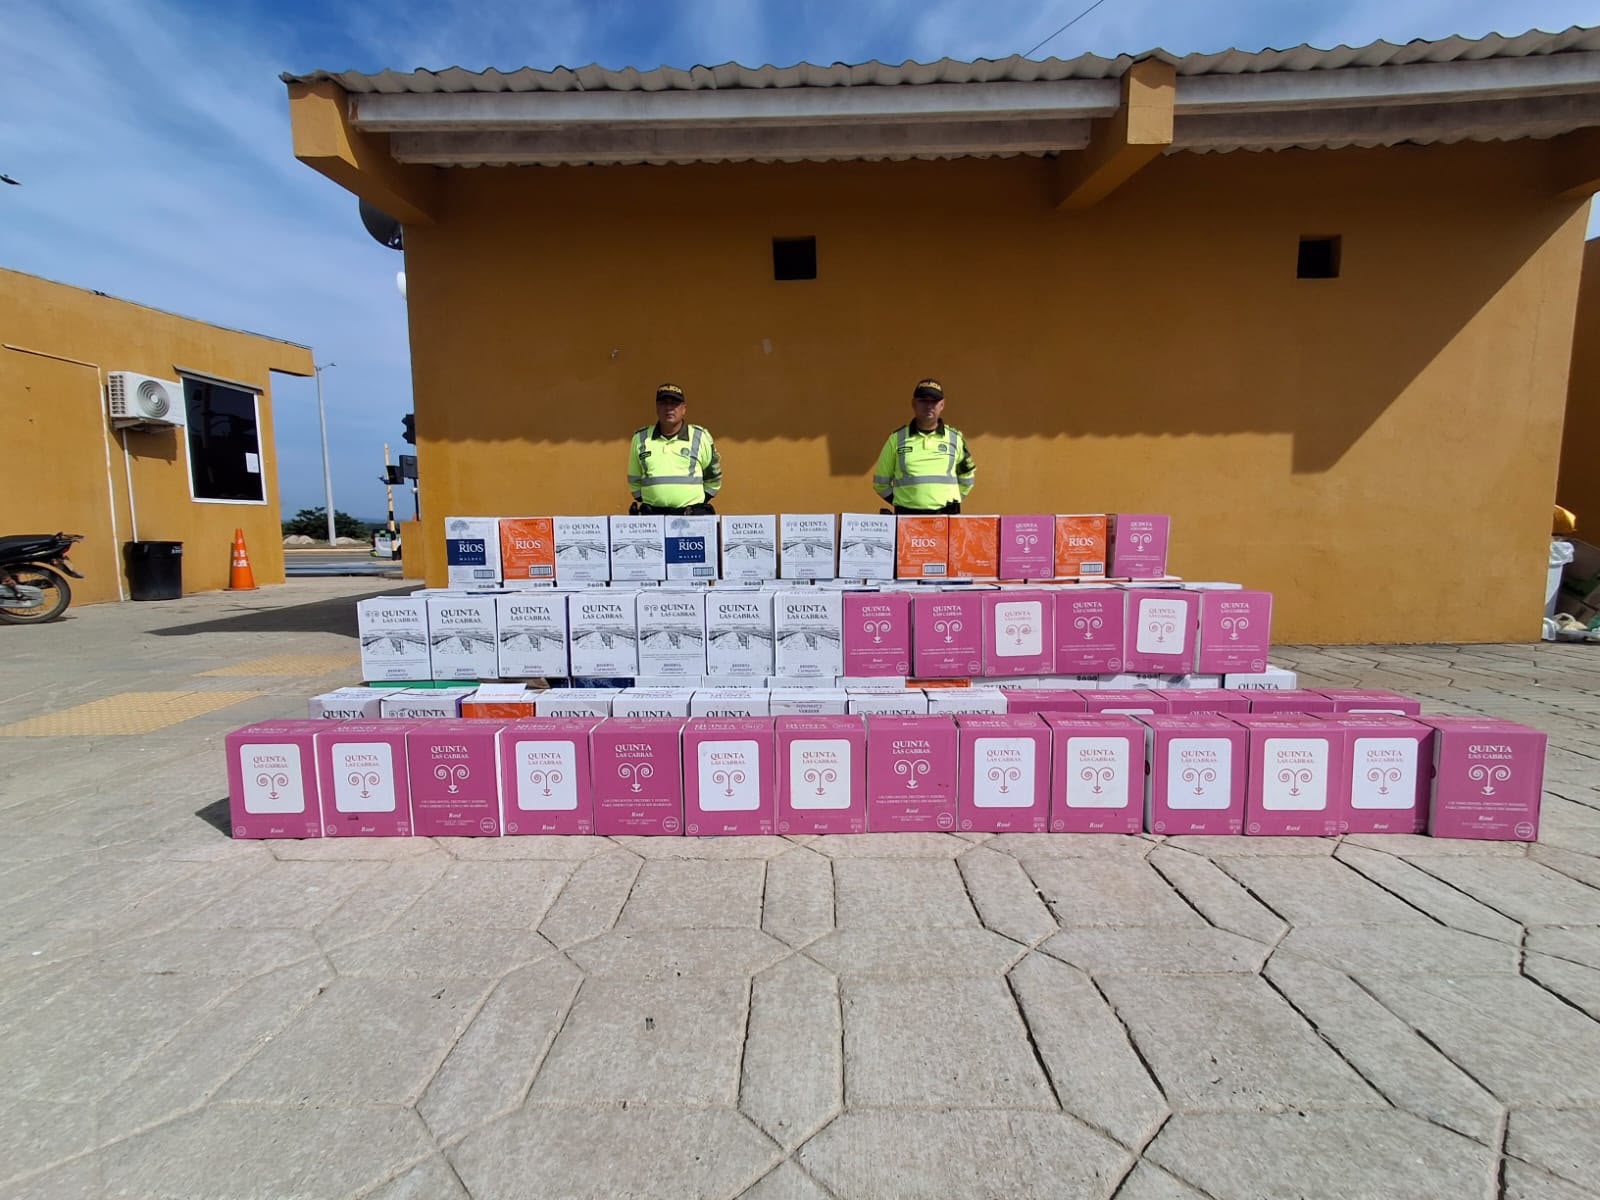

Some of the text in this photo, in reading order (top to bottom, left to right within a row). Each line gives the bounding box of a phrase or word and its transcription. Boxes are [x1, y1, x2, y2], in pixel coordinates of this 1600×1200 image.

[582, 604, 622, 613] QUINTA
[719, 604, 759, 613] QUINTA
[787, 604, 827, 613] QUINTA
[1073, 601, 1102, 609] QUINTA
[382, 609, 417, 618] QUINTA
[440, 609, 481, 617] QUINTA
[510, 606, 550, 615] QUINTA
[322, 710, 365, 719] QUINTA
[407, 709, 446, 718] QUINTA
[615, 743, 652, 752] QUINTA
[892, 740, 930, 749] QUINTA
[1468, 744, 1512, 753] QUINTA
[430, 745, 468, 754] QUINTA
[1181, 750, 1217, 758] QUINTA
[1277, 750, 1313, 758] QUINTA
[344, 754, 378, 762] QUINTA
[527, 752, 561, 760] QUINTA
[710, 752, 745, 760] QUINTA
[802, 751, 836, 759] QUINTA
[253, 756, 287, 764] QUINTA
